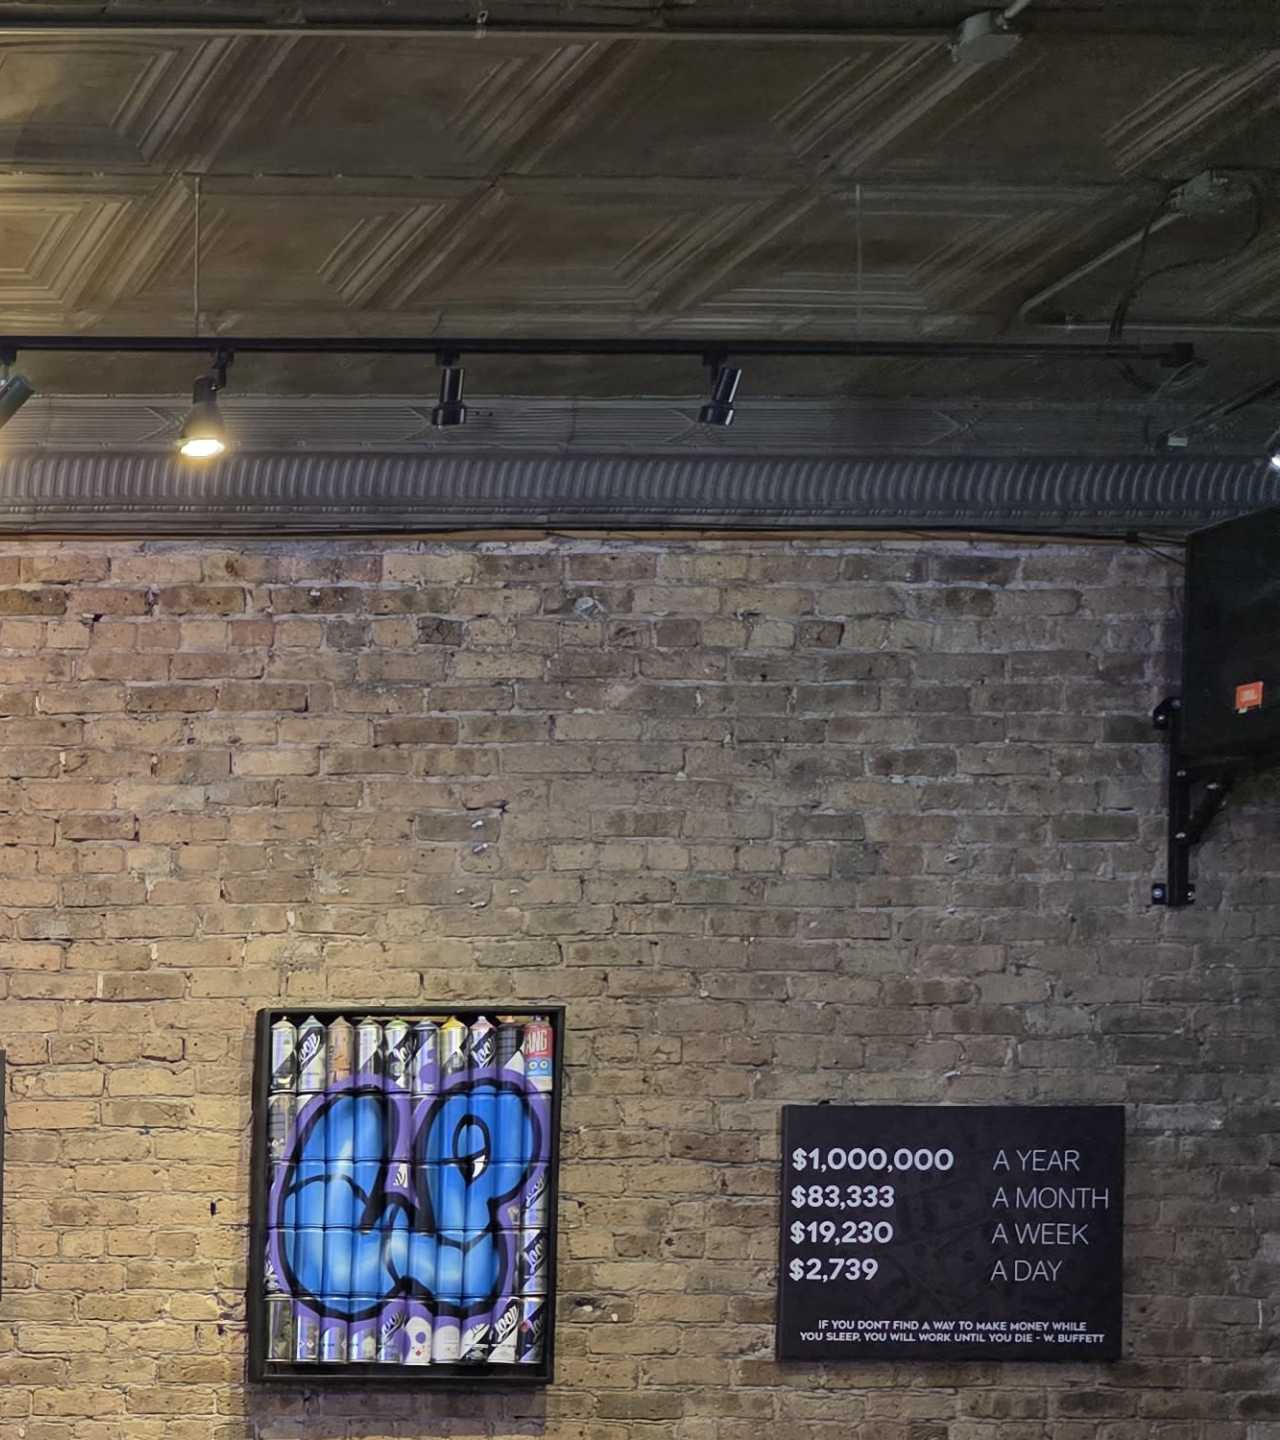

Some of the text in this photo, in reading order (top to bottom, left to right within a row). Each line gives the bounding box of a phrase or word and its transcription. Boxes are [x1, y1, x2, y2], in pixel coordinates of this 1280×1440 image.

[792, 1147, 1080, 1173] $1,000,000 A YEAR
[791, 1185, 1109, 1210] $83,333 A MONTH
[790, 1221, 1089, 1246] $19,230 A WEEK
[789, 1258, 1063, 1283] $2,739 A DAY
[800, 1332, 824, 1341] YOU
[863, 1333, 887, 1342] YOU
[890, 1333, 916, 1342] WILL
[918, 1333, 951, 1342] WORK
[954, 1333, 987, 1343] UNTIL
[989, 1333, 1012, 1343] YOU
[1058, 1334, 1105, 1343] BUFFETT
[818, 1320, 829, 1330] IF
[831, 1320, 855, 1330] YOU
[893, 1320, 920, 1331] FIND
[921, 1321, 931, 1331] A
[933, 1321, 956, 1331] WAY
[958, 1321, 974, 1331] TO
[976, 1321, 1007, 1331] MAKE
[1009, 1322, 1050, 1332] MONEY
[1052, 1322, 1087, 1332] WHILE
